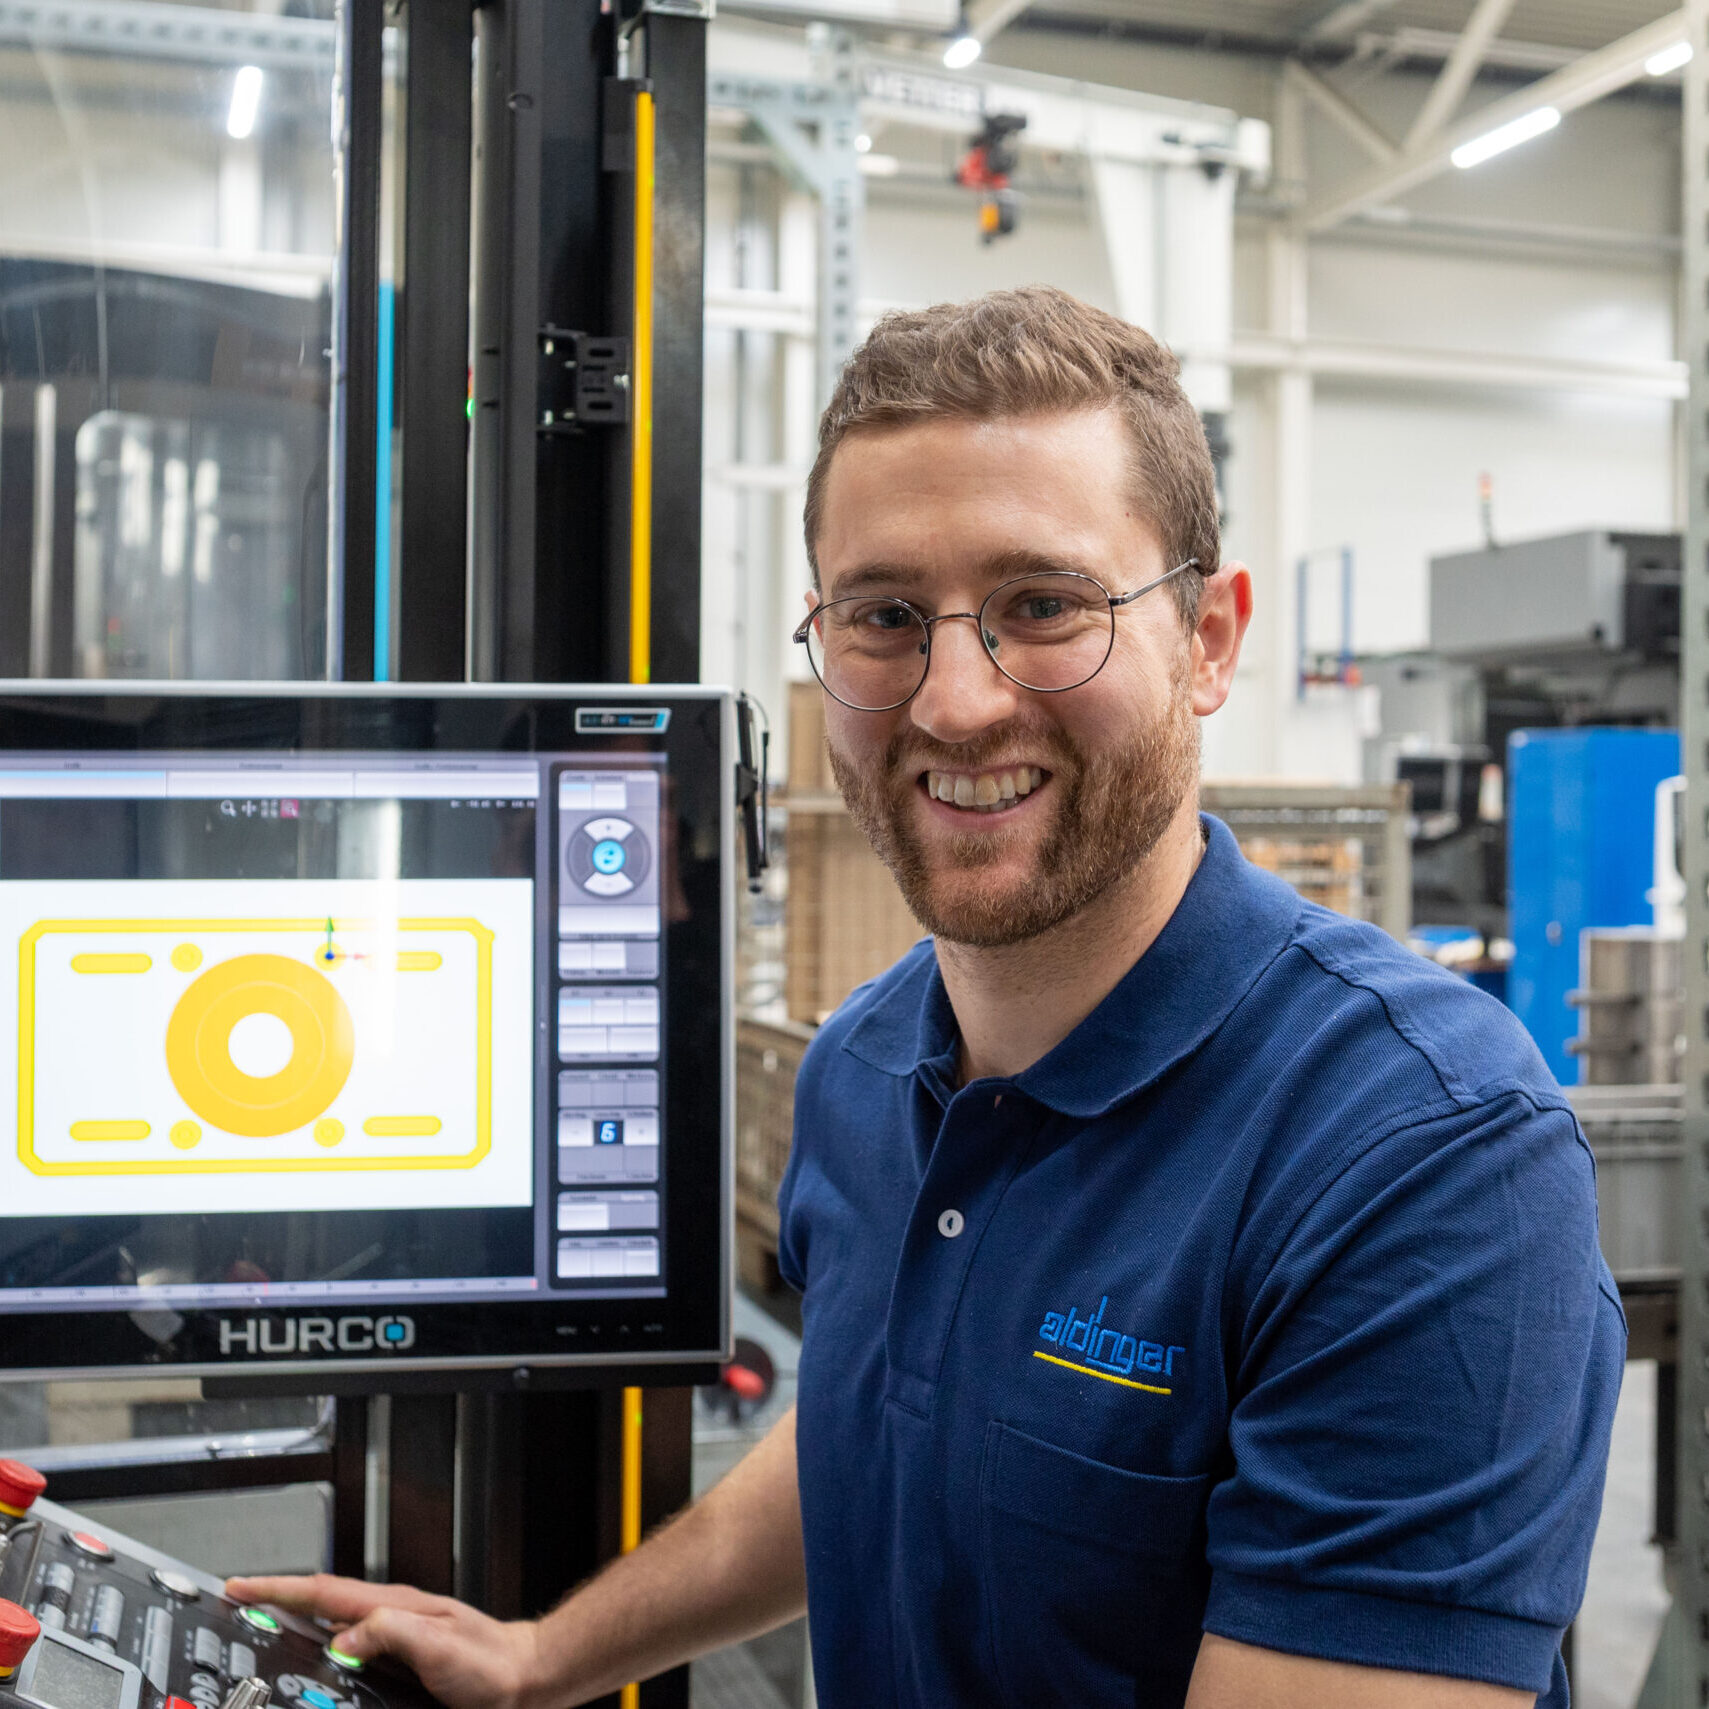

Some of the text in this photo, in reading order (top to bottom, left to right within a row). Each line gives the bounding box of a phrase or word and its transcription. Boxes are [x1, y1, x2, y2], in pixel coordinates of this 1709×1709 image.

[600, 1122, 616, 1143] 6
[219, 1315, 416, 1355] HURCO
[1039, 1295, 1186, 1376] aldinger
